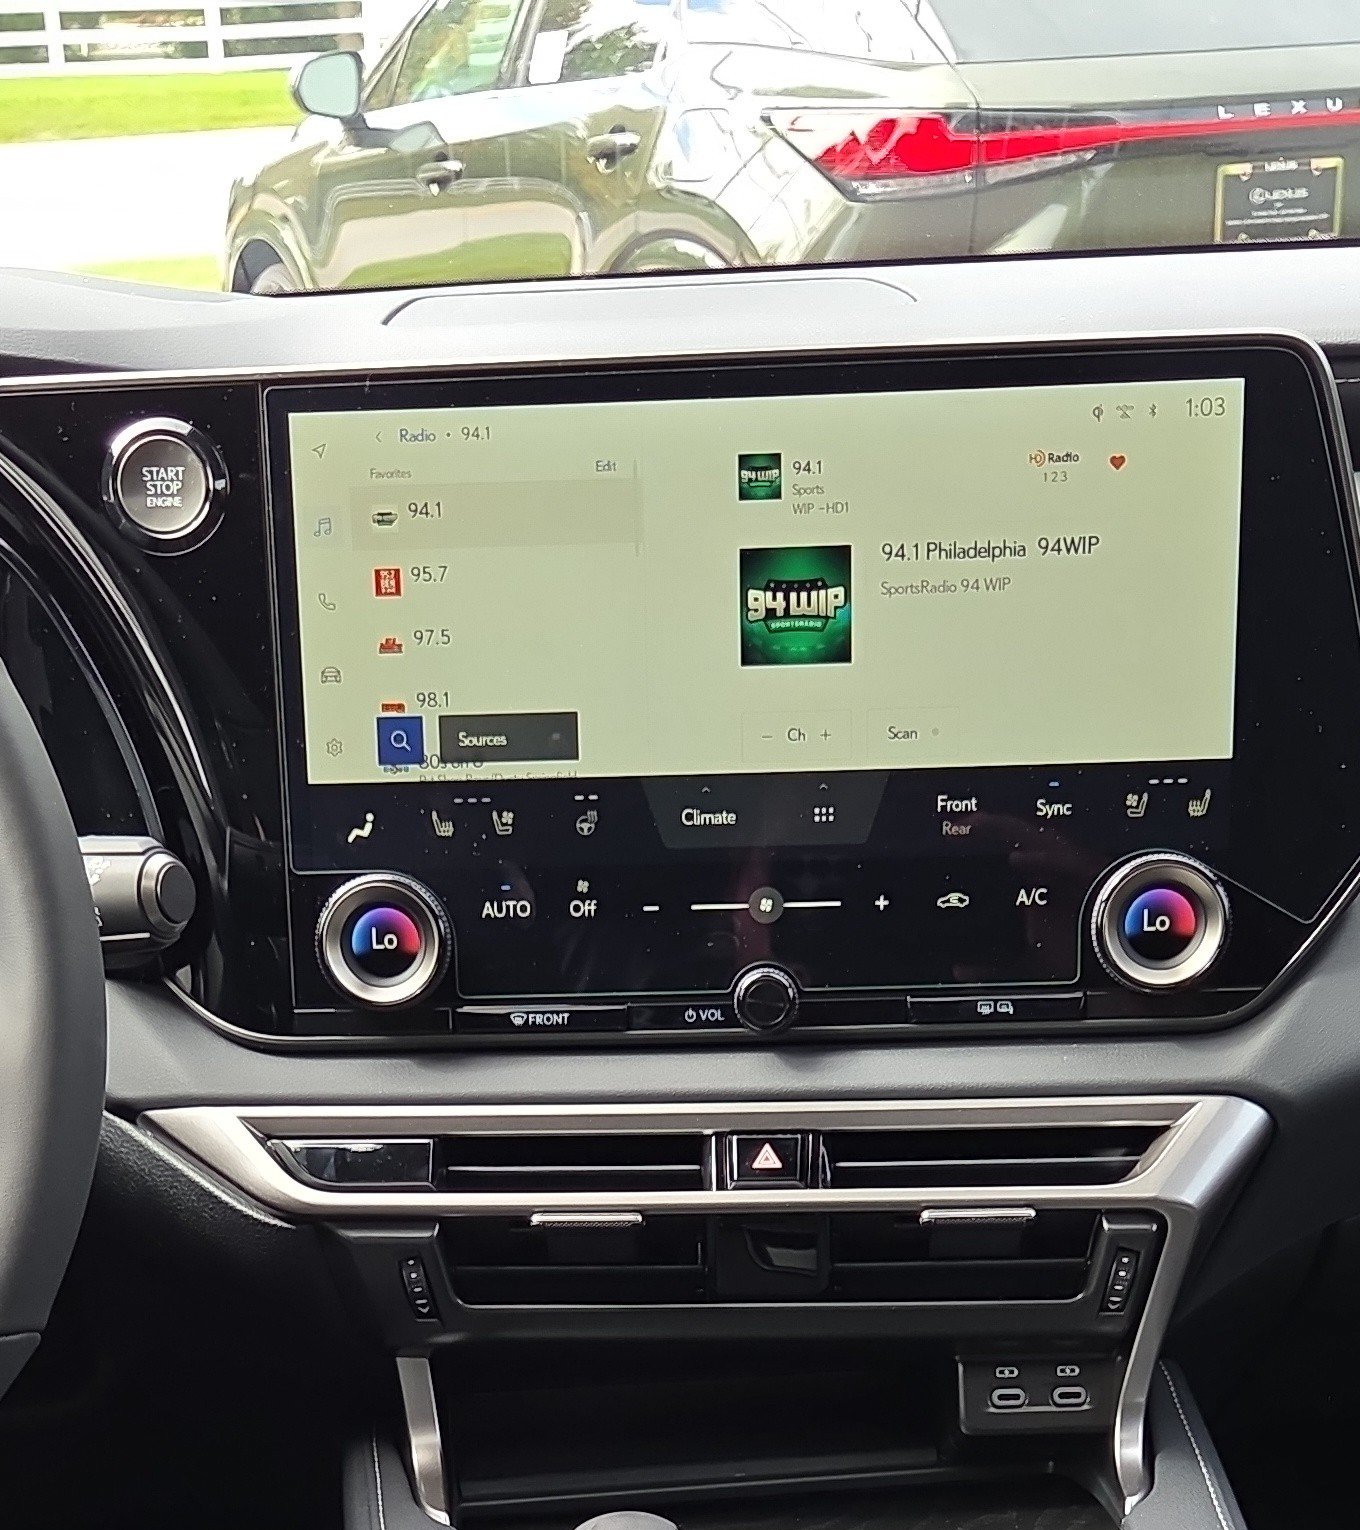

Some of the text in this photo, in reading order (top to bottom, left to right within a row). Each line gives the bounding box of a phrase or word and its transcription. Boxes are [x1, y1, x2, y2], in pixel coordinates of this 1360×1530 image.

[1185, 397, 1226, 418] 1:03
[399, 426, 491, 443] Radio 94.1
[1047, 451, 1080, 464] Radio
[141, 466, 186, 482] START
[369, 468, 412, 480] Favorites
[595, 460, 618, 473] Edit
[792, 460, 823, 475] 94.1
[146, 481, 182, 495] STOP
[792, 484, 825, 497] Sports
[146, 496, 183, 508] ENGINE
[408, 501, 442, 519] 94.1
[792, 503, 815, 515] WIP
[881, 535, 1101, 563] 94.1 Philadelphia 94WIP
[410, 565, 448, 583] 95.7
[880, 577, 1012, 599] SportsRadio 94 WIP
[747, 586, 846, 622] 94 WIP
[413, 629, 451, 646] 97.5
[416, 691, 450, 709] 98.1
[457, 731, 508, 748] Sources
[787, 727, 807, 743] Ch
[887, 726, 919, 741] Scan
[937, 795, 978, 813] Front
[1036, 800, 1072, 820] Sync
[681, 807, 738, 827] Climate
[941, 821, 972, 837] Rear
[1015, 888, 1048, 908] A/C
[481, 900, 532, 919] AUTO
[569, 900, 597, 919] Off
[1142, 908, 1171, 933] Lo
[371, 926, 398, 951] Lo
[528, 1012, 570, 1026] FRONT
[699, 1008, 726, 1022] VOL
